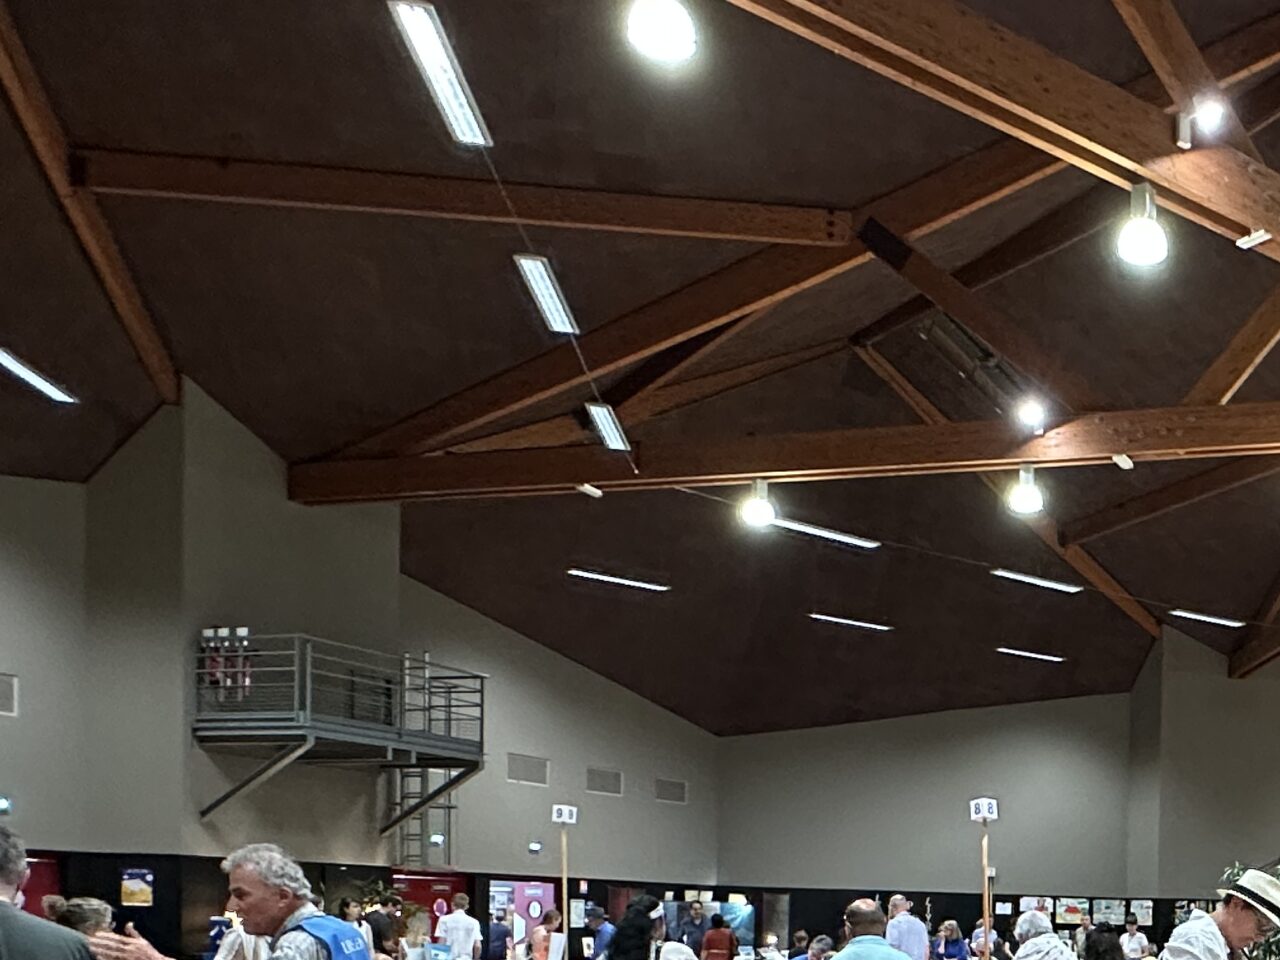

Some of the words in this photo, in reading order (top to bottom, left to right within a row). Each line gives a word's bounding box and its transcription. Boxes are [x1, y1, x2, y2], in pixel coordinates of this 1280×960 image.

[556, 807, 563, 819] 9
[974, 802, 981, 815] 8
[987, 802, 994, 815] 8
